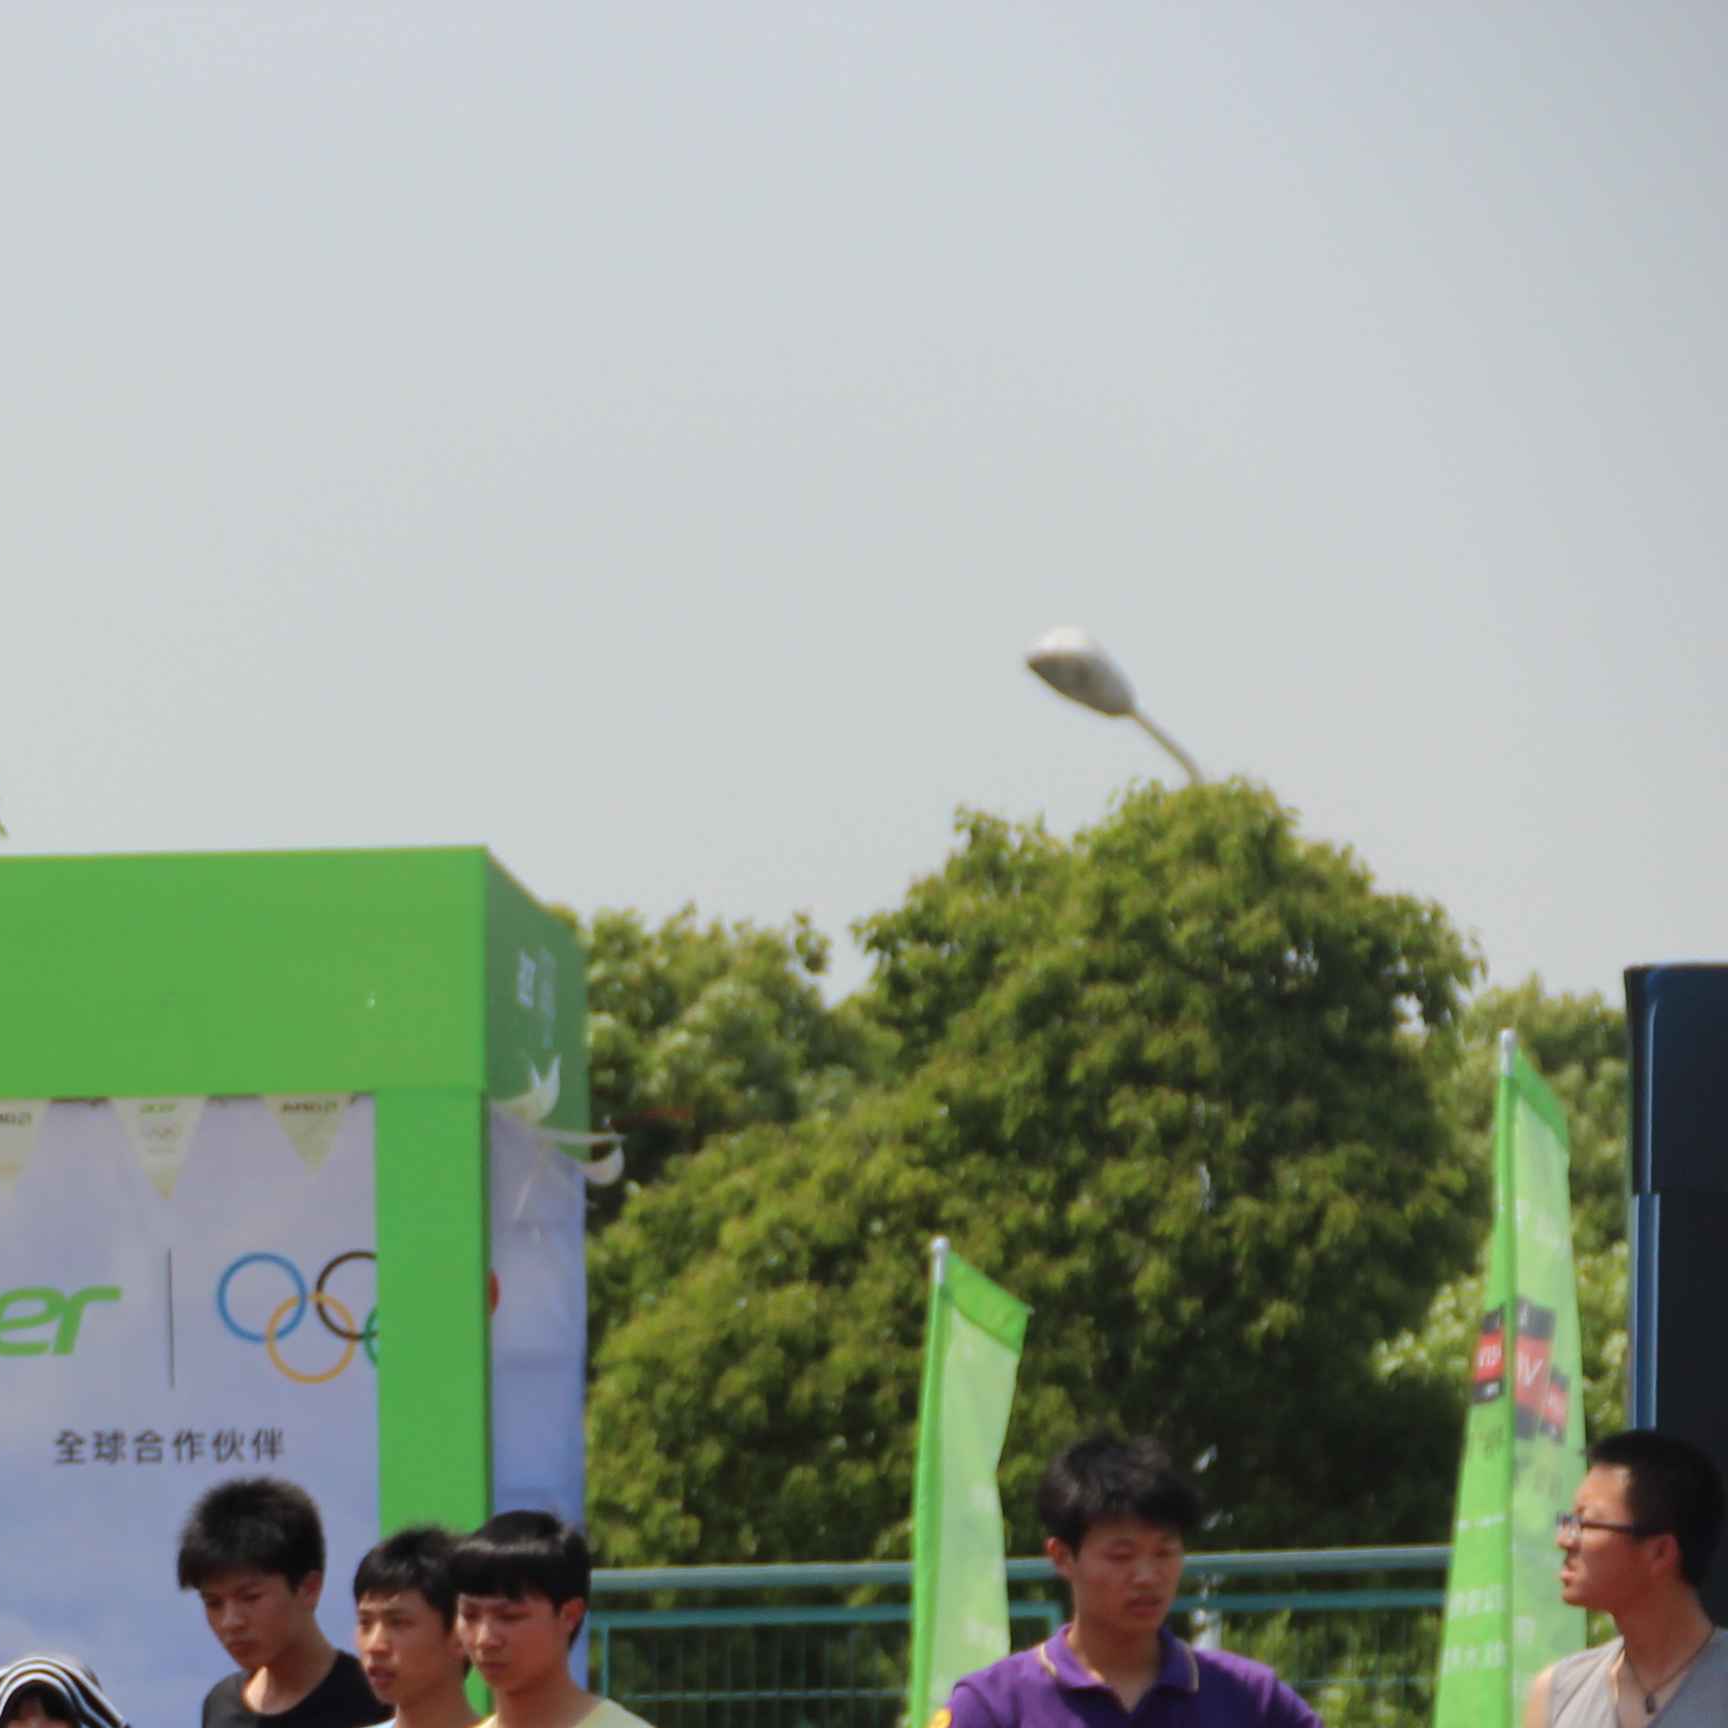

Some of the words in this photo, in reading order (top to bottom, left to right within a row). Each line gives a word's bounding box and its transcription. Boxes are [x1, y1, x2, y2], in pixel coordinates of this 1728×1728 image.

[54, 1428, 286, 1465] 全球合作伙伴
